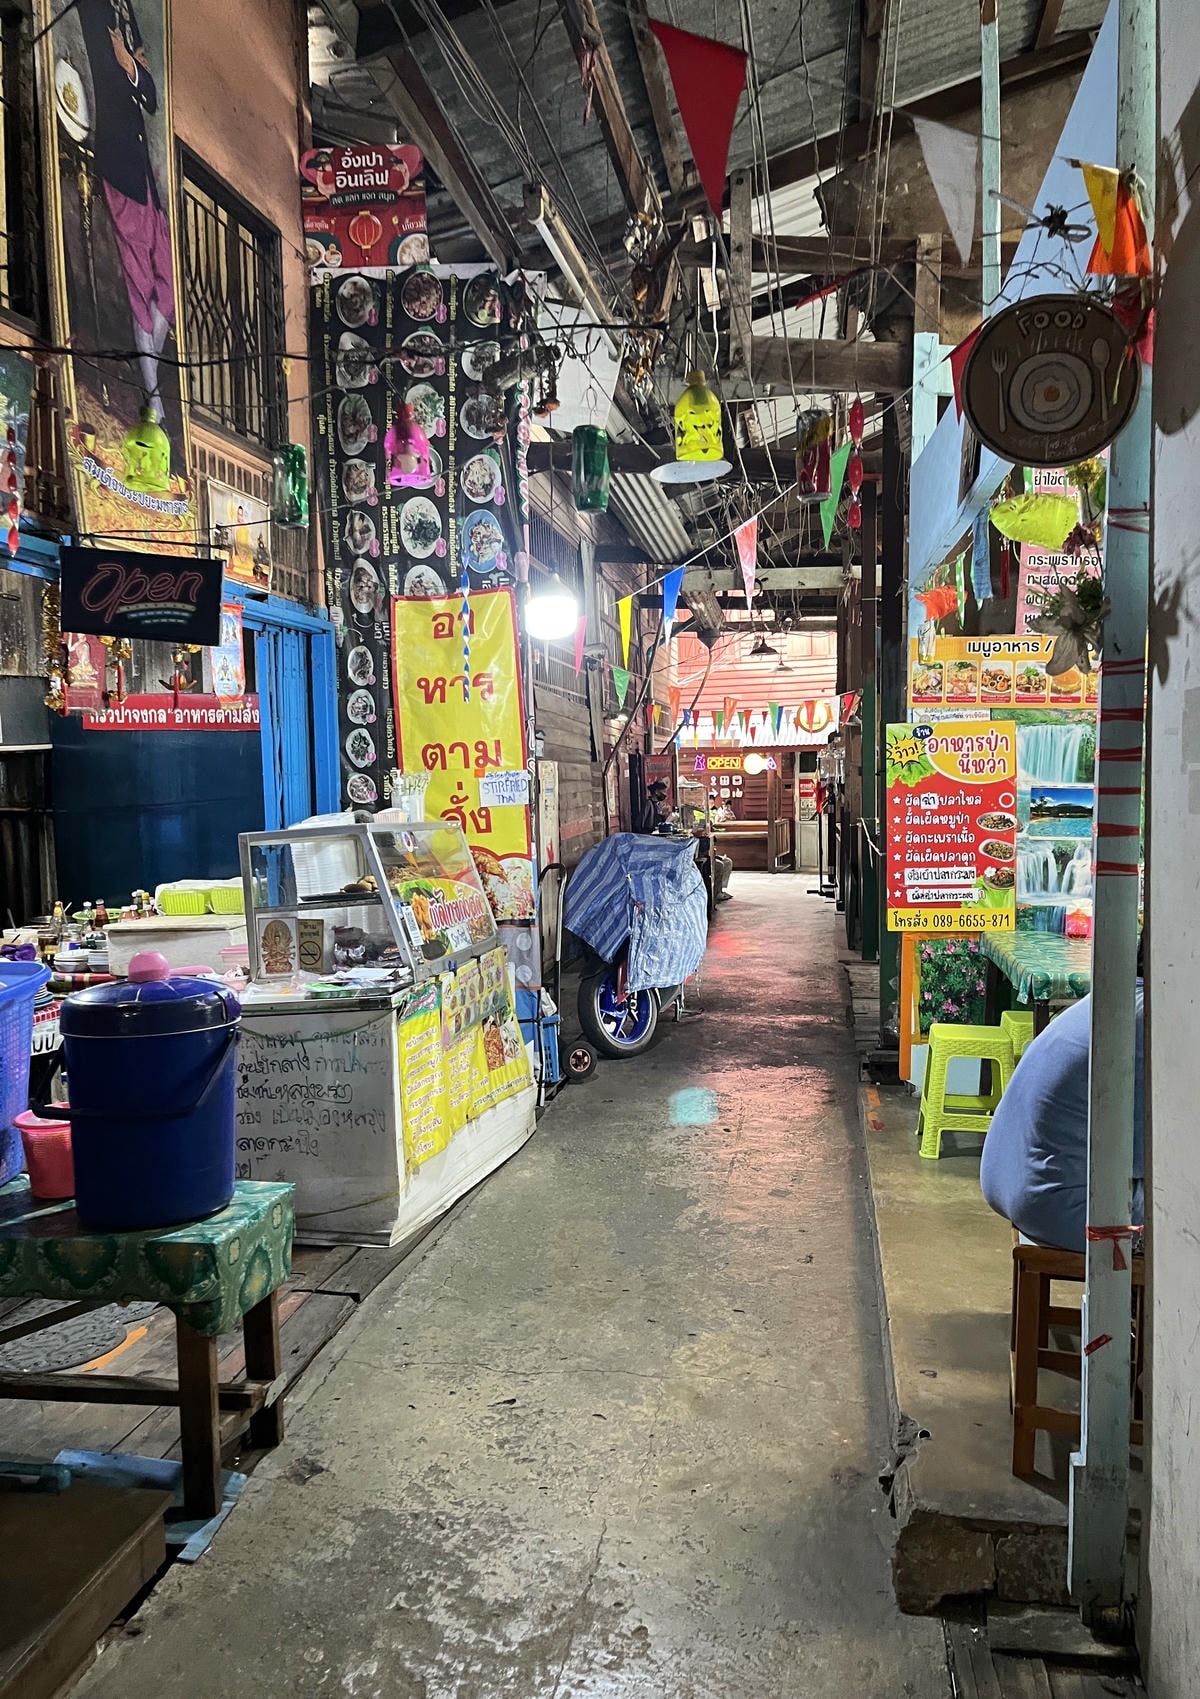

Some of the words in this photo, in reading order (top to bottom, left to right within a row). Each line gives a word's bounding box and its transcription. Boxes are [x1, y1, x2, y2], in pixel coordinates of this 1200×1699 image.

[341, 148, 383, 168] อั่งเปา
[336, 168, 389, 188] อินเลิฟ
[1018, 311, 1085, 337] FOOD
[81, 563, 203, 623] Open
[431, 609, 475, 639] อา
[967, 640, 1039, 657] เมนูอาหาร
[416, 672, 494, 705] หาร
[915, 727, 931, 738] ร้าน
[927, 730, 1009, 753] อาหารป่า
[421, 738, 502, 771] ตาม
[708, 758, 739, 768] OPEN
[440, 781, 492, 834] สั่ง
[905, 828, 975, 844] ผัดกะเพราเนื้อ
[905, 848, 976, 865] ผัดเผ็ดปลาดุก
[893, 910, 928, 928] โทรสั่ง
[933, 914, 1010, 927] 089-6655-871
